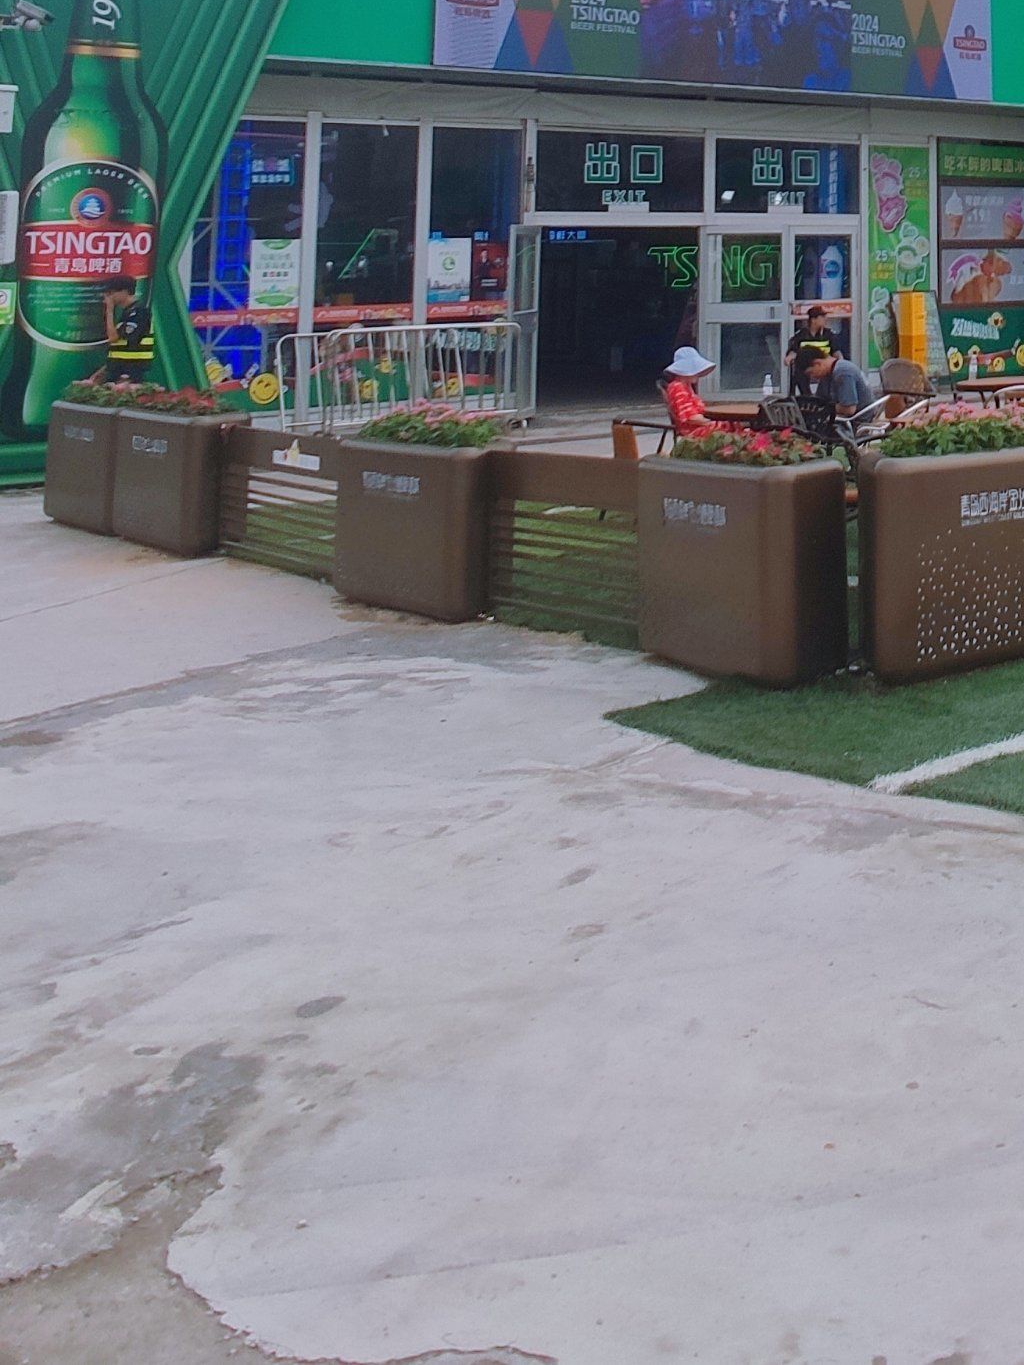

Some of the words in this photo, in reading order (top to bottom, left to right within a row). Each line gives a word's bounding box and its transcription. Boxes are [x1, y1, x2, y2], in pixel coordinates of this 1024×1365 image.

[571, 5, 641, 25] TSINGTAO
[852, 13, 879, 33] 2024
[852, 32, 906, 49] TSINGTAO
[584, 141, 664, 184] 出口
[752, 146, 821, 186] 出口
[602, 189, 647, 204] EXIT
[24, 231, 152, 255] TSINGTAO
